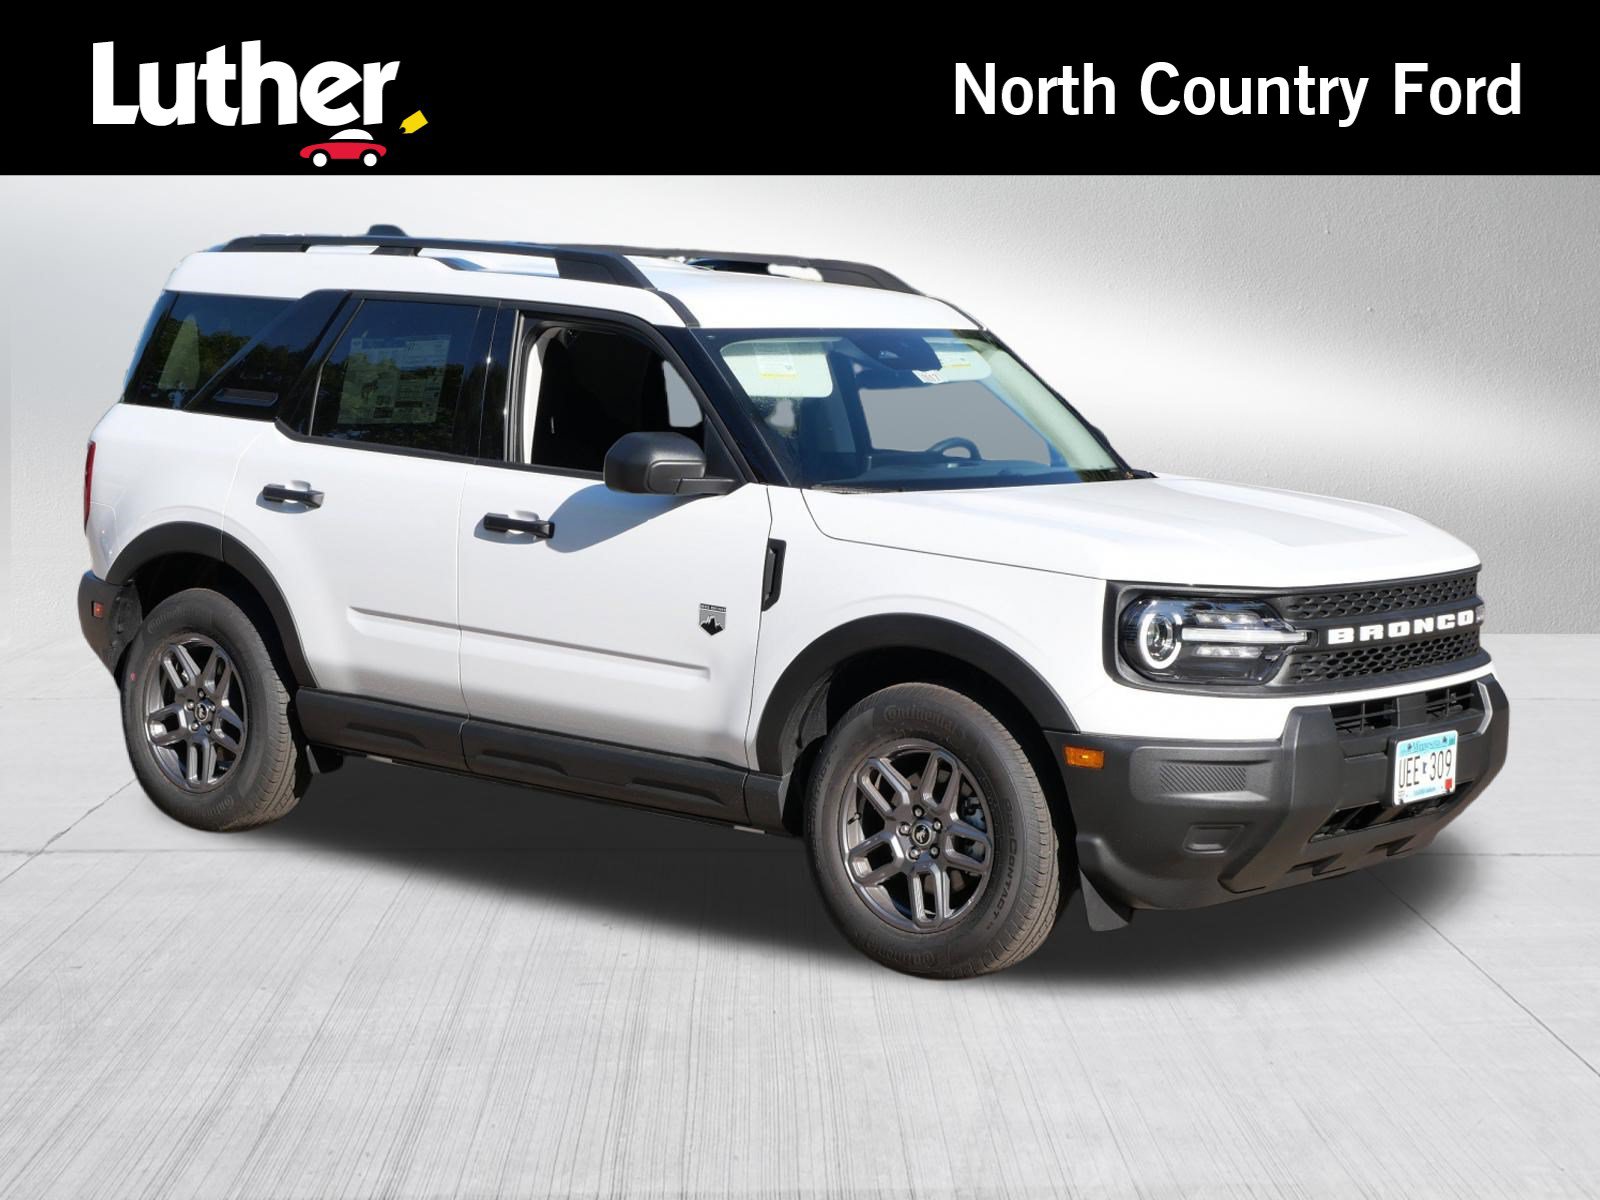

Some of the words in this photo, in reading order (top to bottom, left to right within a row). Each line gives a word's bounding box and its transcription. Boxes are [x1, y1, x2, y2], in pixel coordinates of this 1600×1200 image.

[1328, 610, 1474, 645] BRONCO
[1399, 755, 1420, 788] UEE
[1430, 749, 1452, 780] 309
